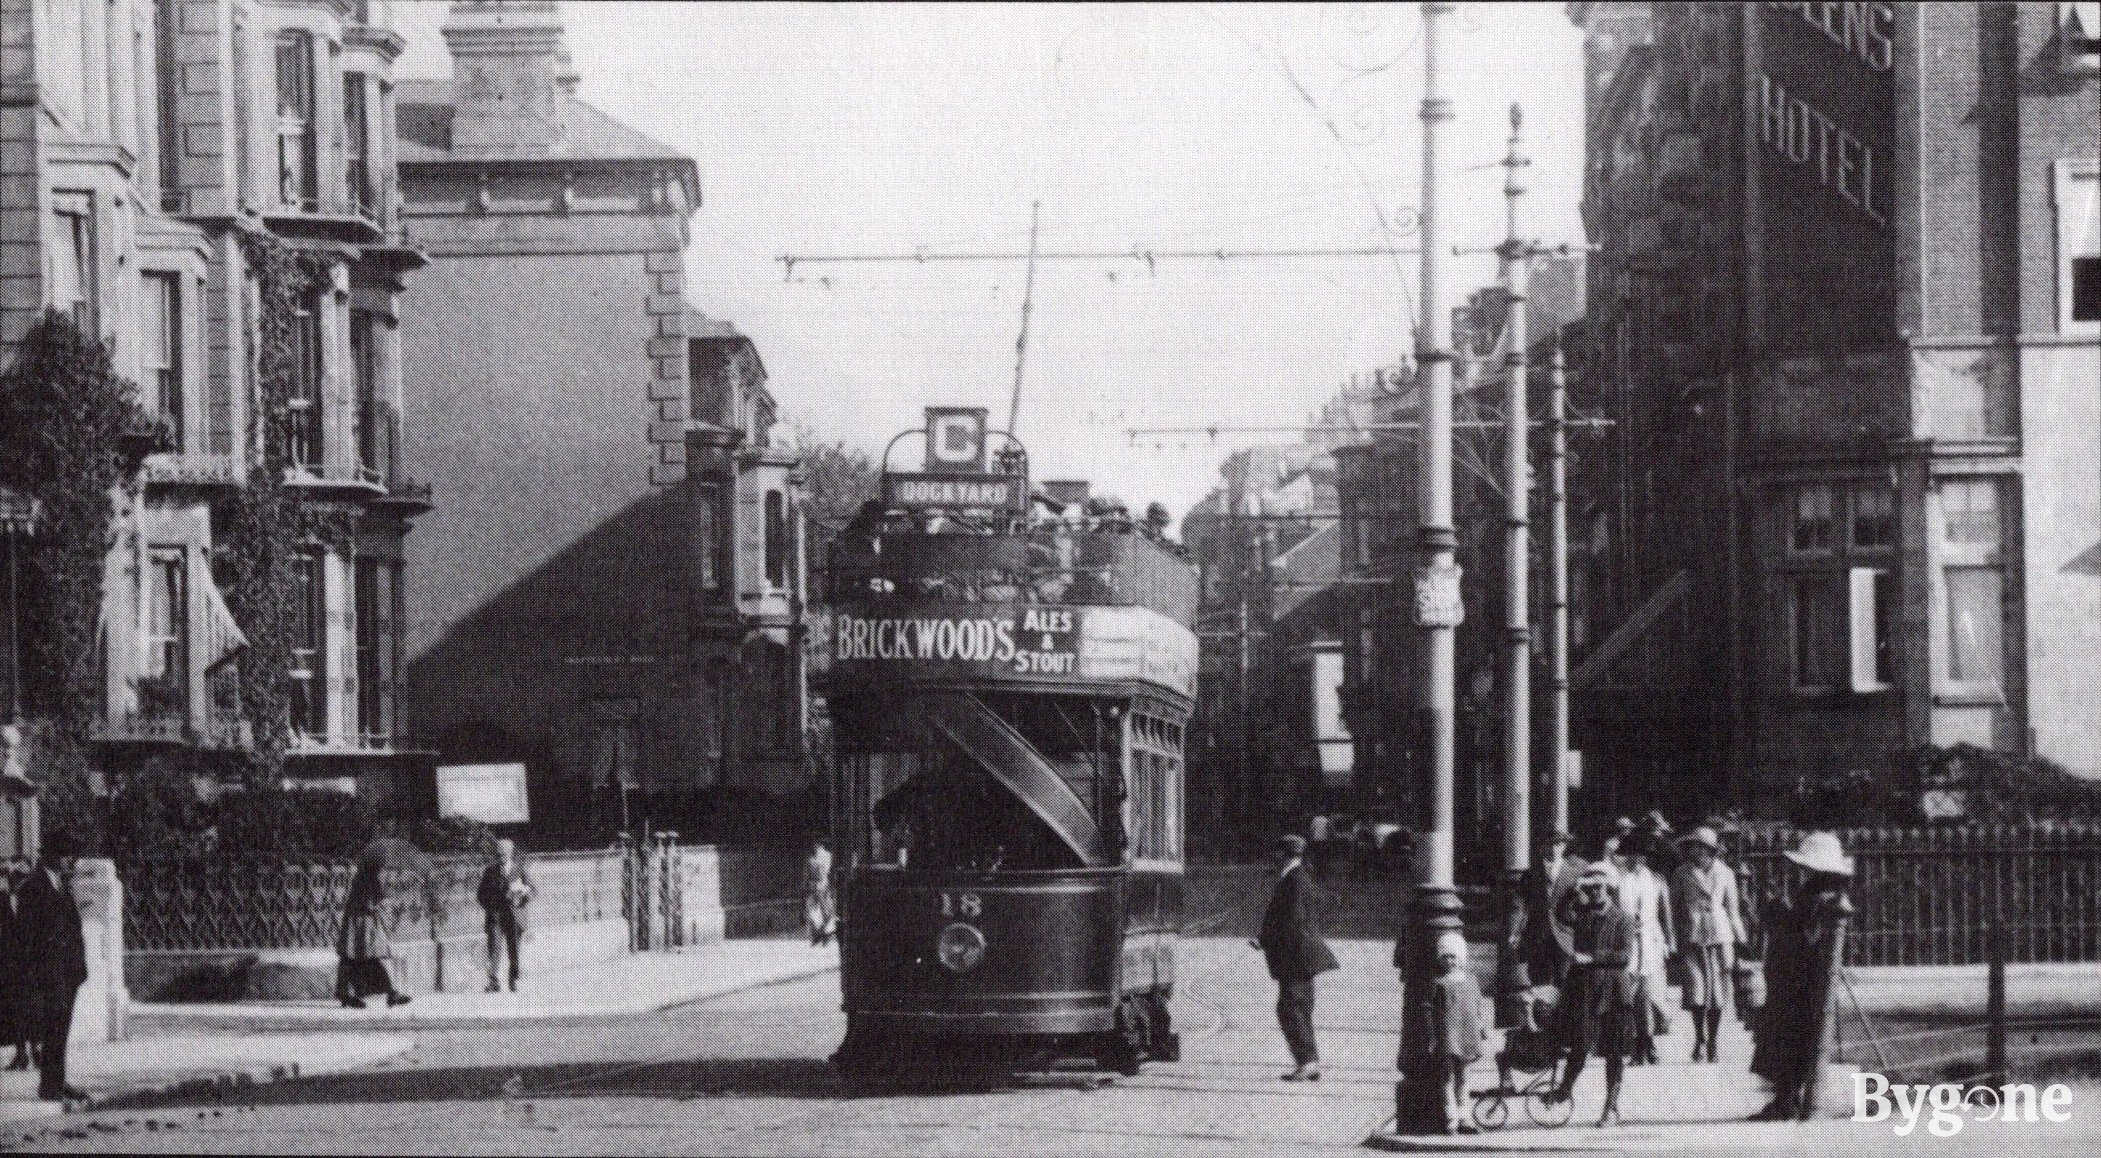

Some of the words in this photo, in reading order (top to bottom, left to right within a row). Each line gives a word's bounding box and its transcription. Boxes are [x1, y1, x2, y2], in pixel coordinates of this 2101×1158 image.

[1762, 74, 1886, 225] HOTEL
[934, 415, 978, 462] C
[902, 481, 1008, 504] DOCKYARD
[1024, 609, 1073, 632] ALES
[836, 614, 1015, 661] BRICKWOOD'S
[1041, 633, 1054, 650] &
[1014, 649, 1075, 674] STOUT
[941, 892, 983, 916] 18
